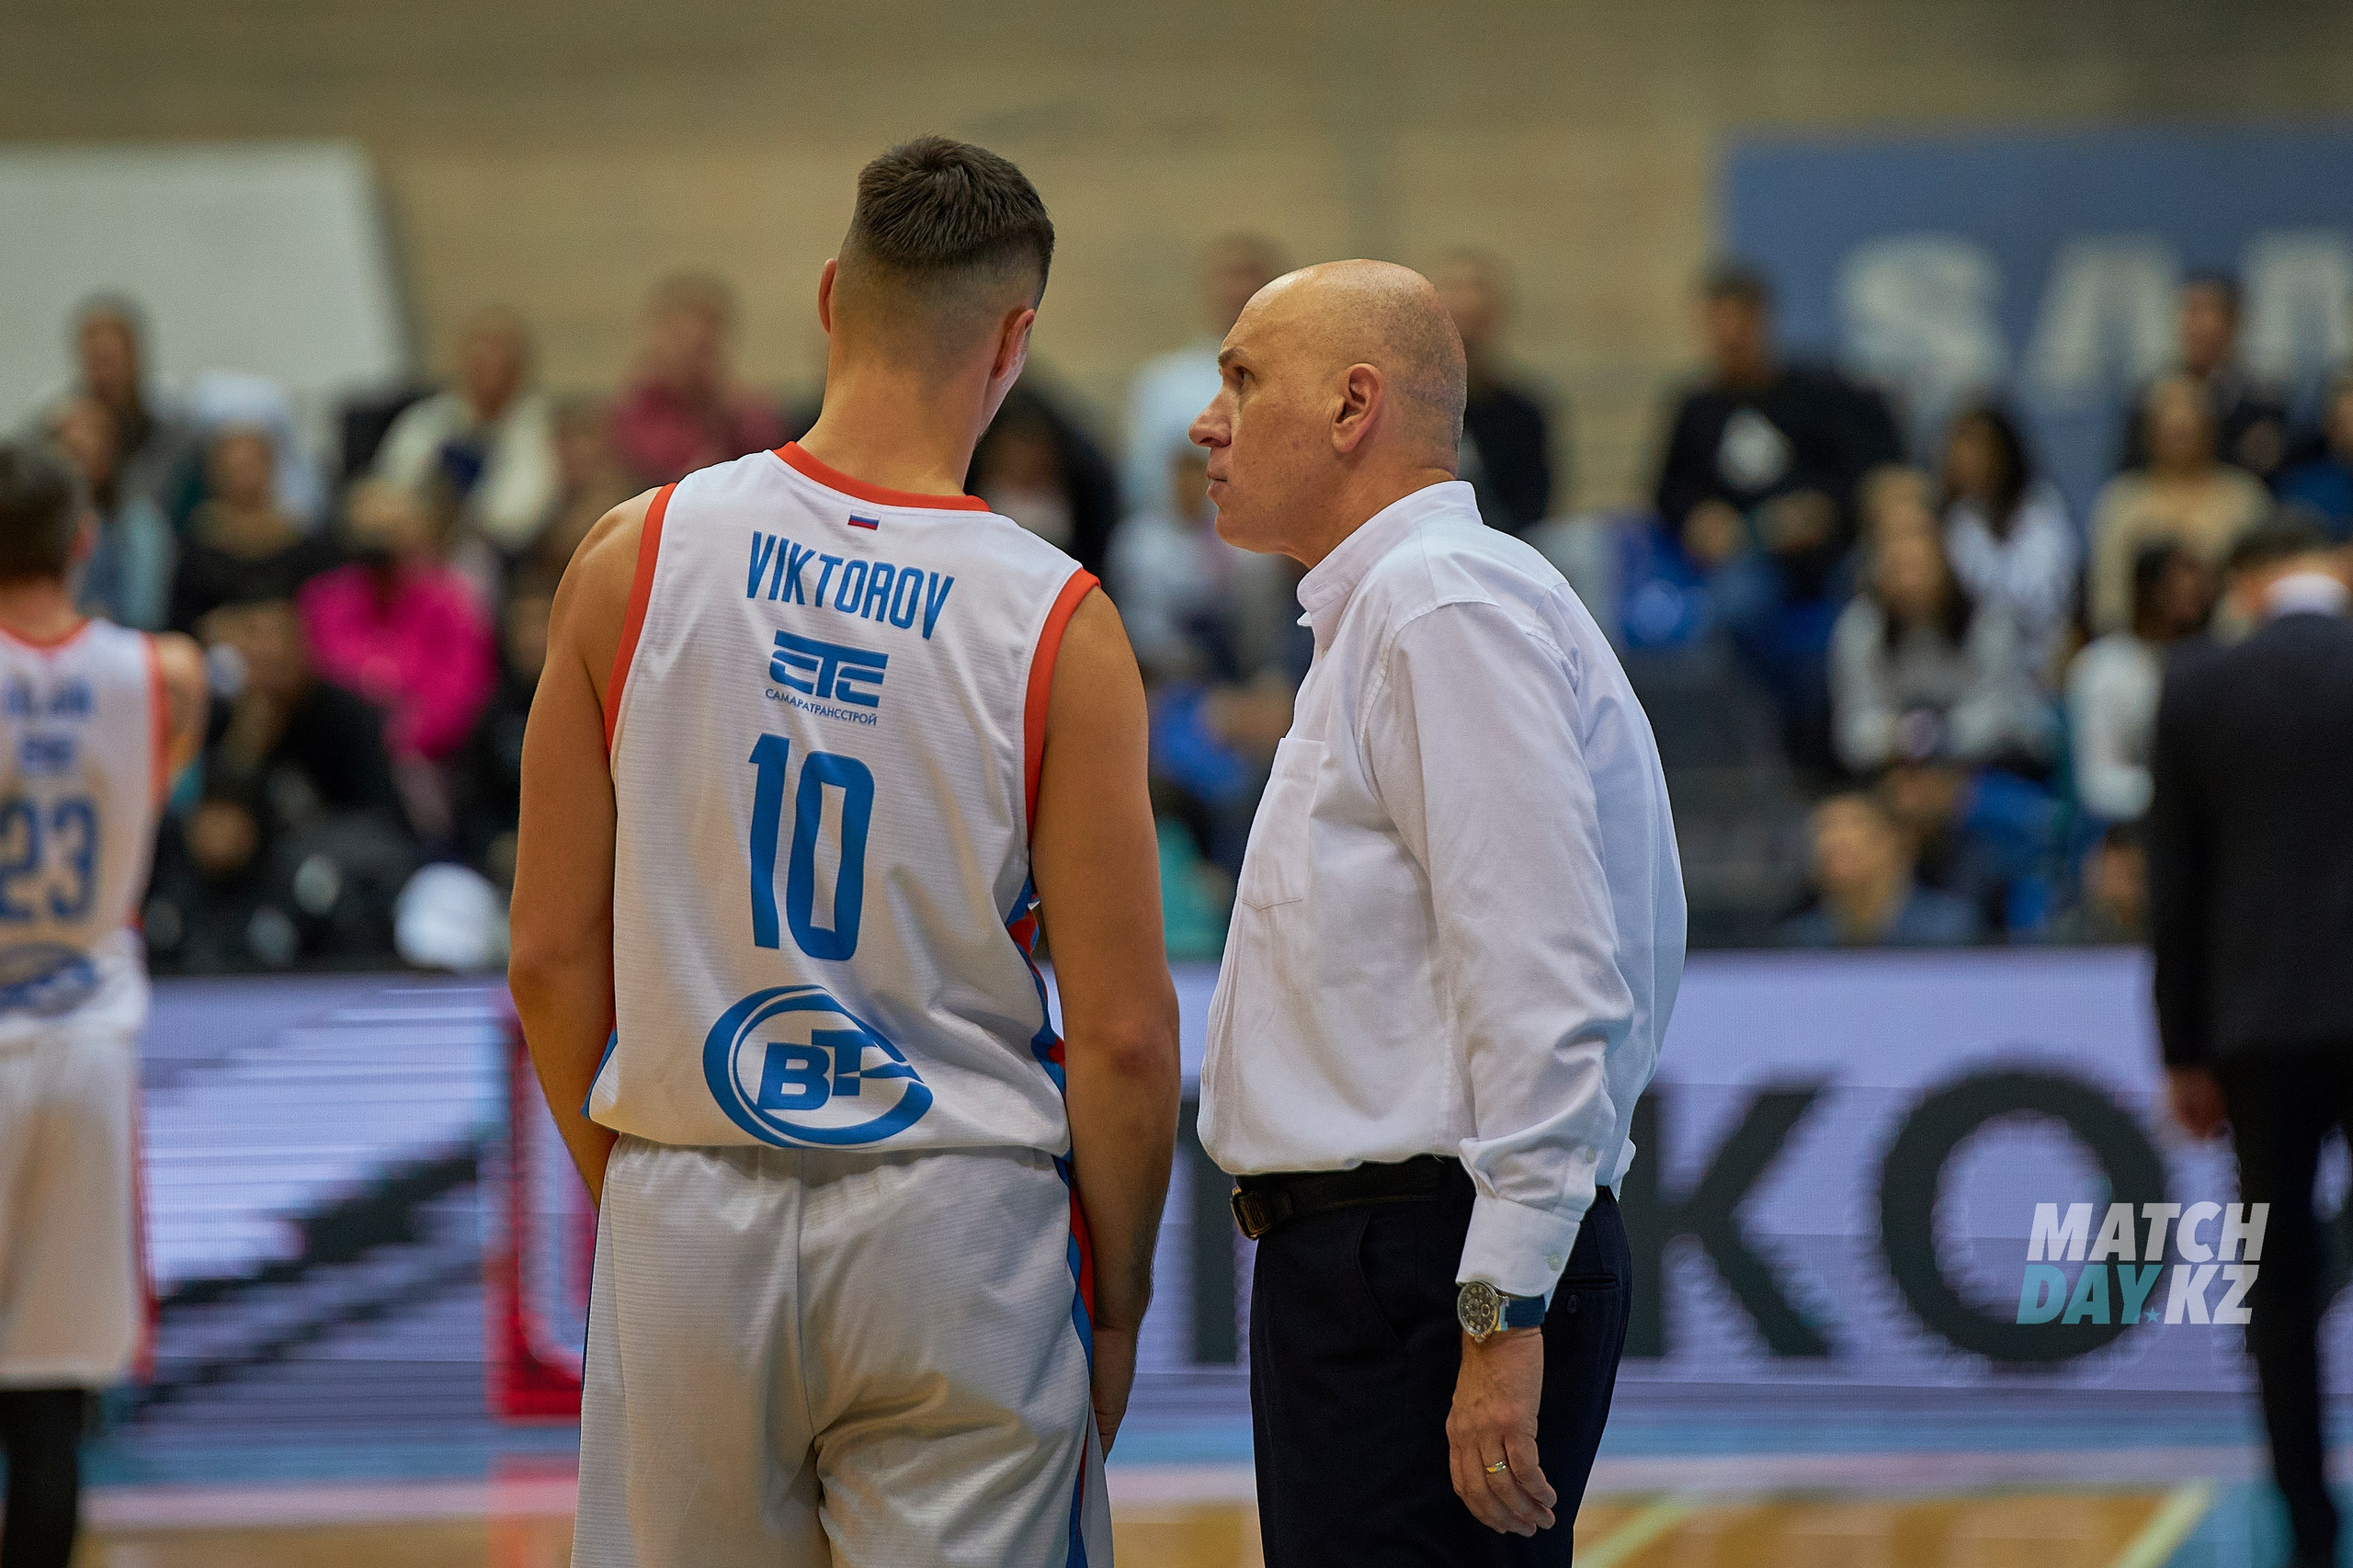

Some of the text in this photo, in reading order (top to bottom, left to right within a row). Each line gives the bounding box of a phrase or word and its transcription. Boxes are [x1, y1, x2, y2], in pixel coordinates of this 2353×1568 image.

[746, 530, 955, 641] VIKTOROV
[765, 688, 878, 726] САМАРАТРАНССТРОЙ
[0, 798, 101, 923] 23
[748, 733, 875, 961] 10
